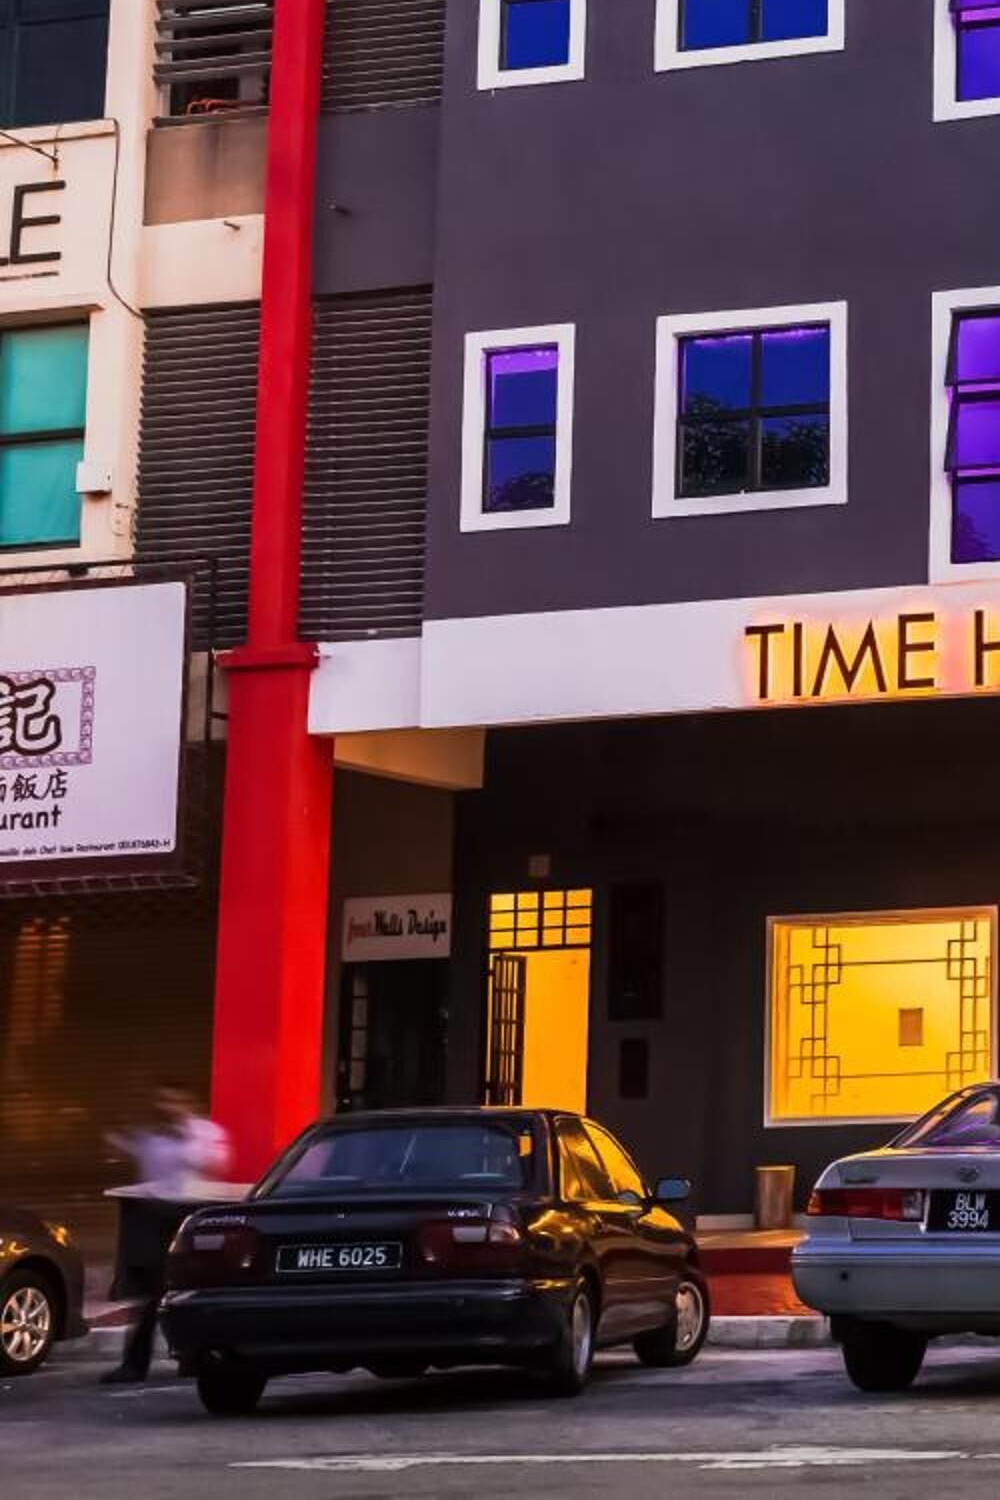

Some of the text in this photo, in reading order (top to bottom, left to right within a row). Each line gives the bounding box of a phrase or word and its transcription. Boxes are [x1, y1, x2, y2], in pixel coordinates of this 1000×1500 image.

[0, 180, 66, 266] E
[744, 611, 936, 699] TIME
[0, 767, 69, 803] 飯店
[947, 1209, 989, 1229] 3994
[297, 1246, 387, 1268] WHE 6025
